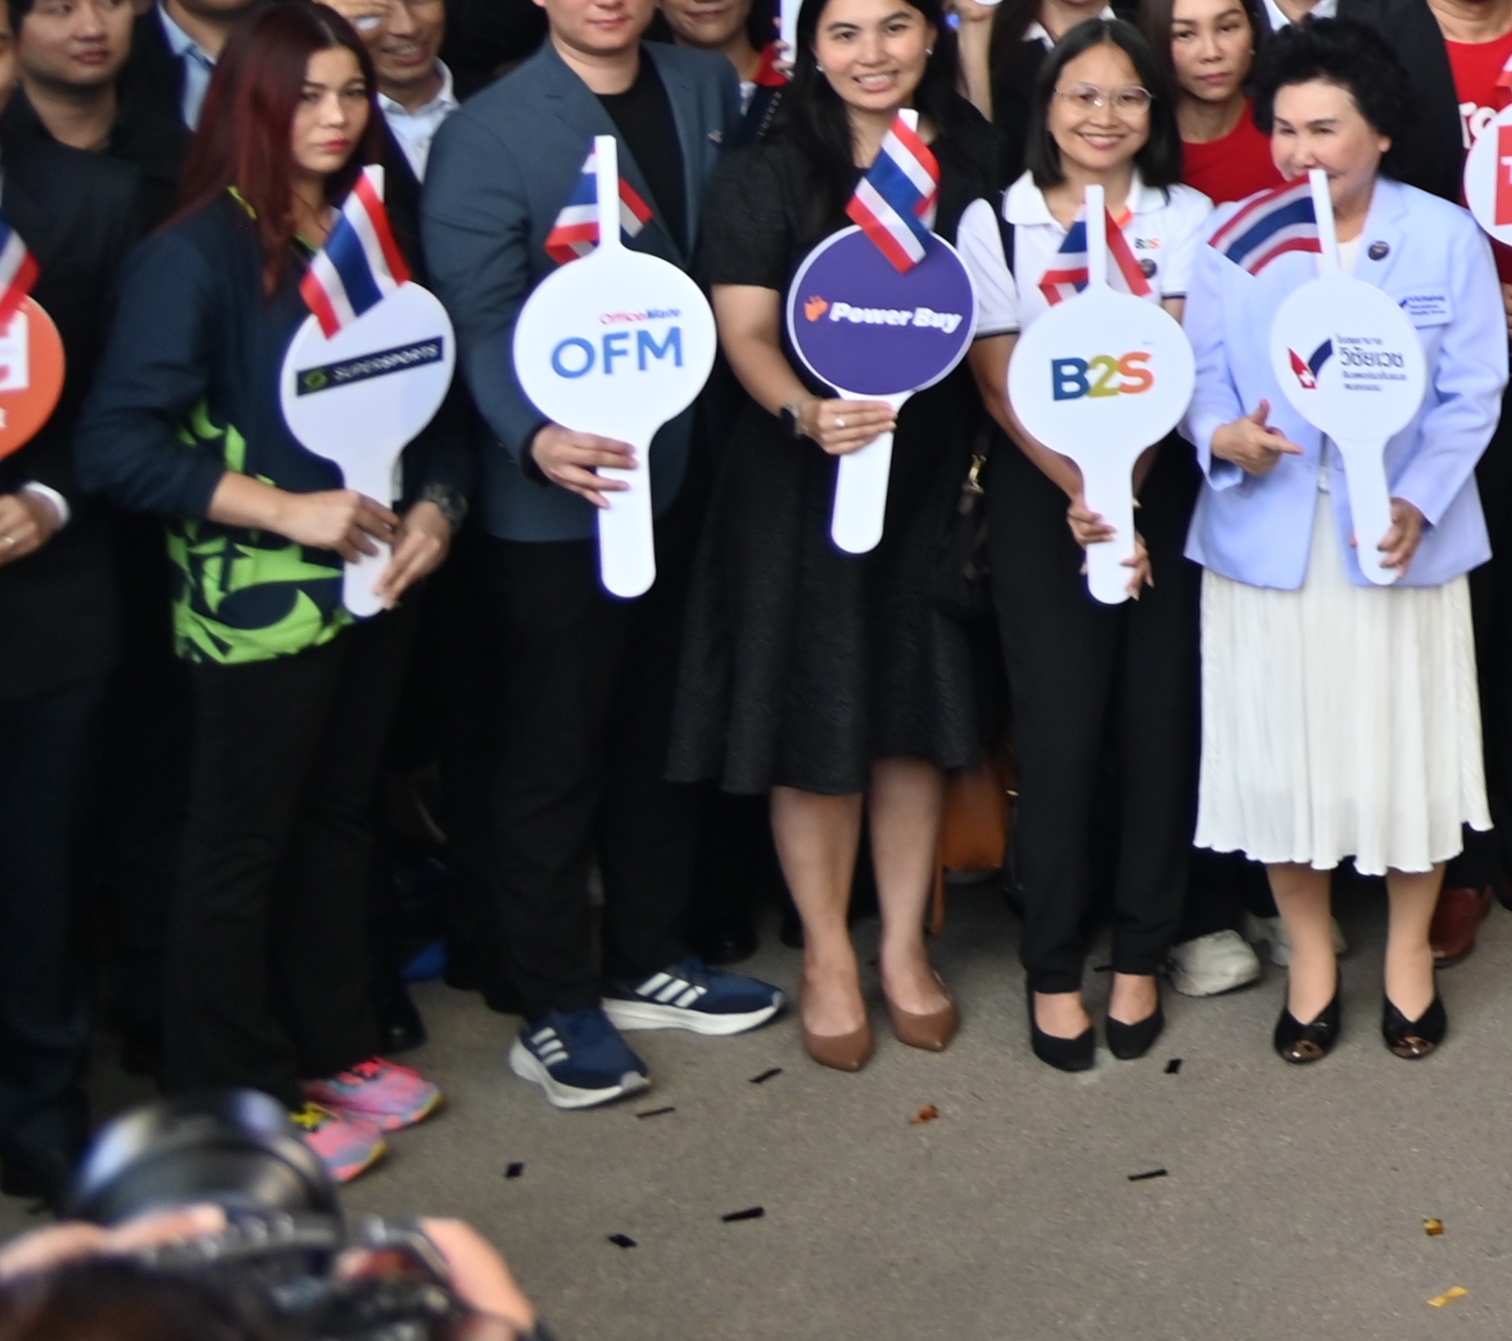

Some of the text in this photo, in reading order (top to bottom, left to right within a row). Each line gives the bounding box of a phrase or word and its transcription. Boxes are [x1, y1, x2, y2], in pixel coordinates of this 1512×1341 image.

[599, 308, 682, 325] OfficeMate
[828, 302, 964, 334] Power Buy
[550, 325, 684, 379] OFM
[1051, 350, 1155, 402] B2S
